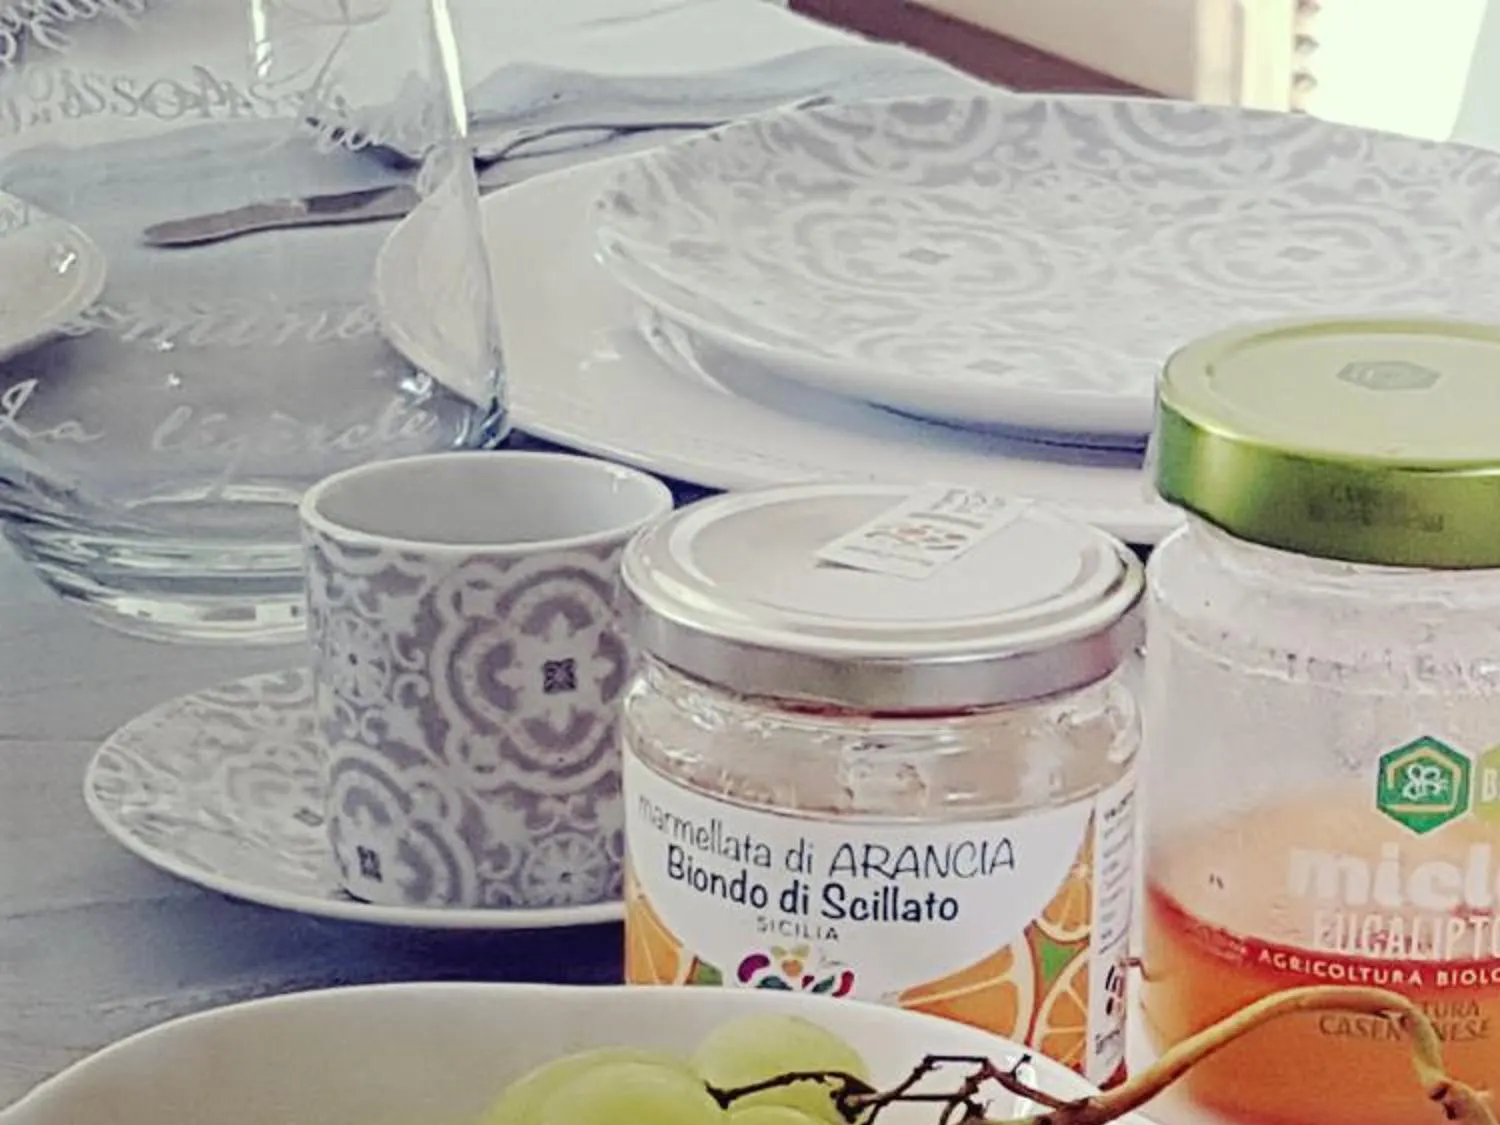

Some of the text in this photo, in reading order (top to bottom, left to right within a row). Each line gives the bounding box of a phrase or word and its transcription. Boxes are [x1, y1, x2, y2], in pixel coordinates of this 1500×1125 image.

[639, 794, 1016, 880] marmellata di ARANCIA
[667, 843, 959, 922] Biondo di Scillato
[757, 915, 839, 941] SICILIA
[1258, 948, 1423, 986] AGRICOLTURA
[1318, 1011, 1491, 1042] CASENNESE
